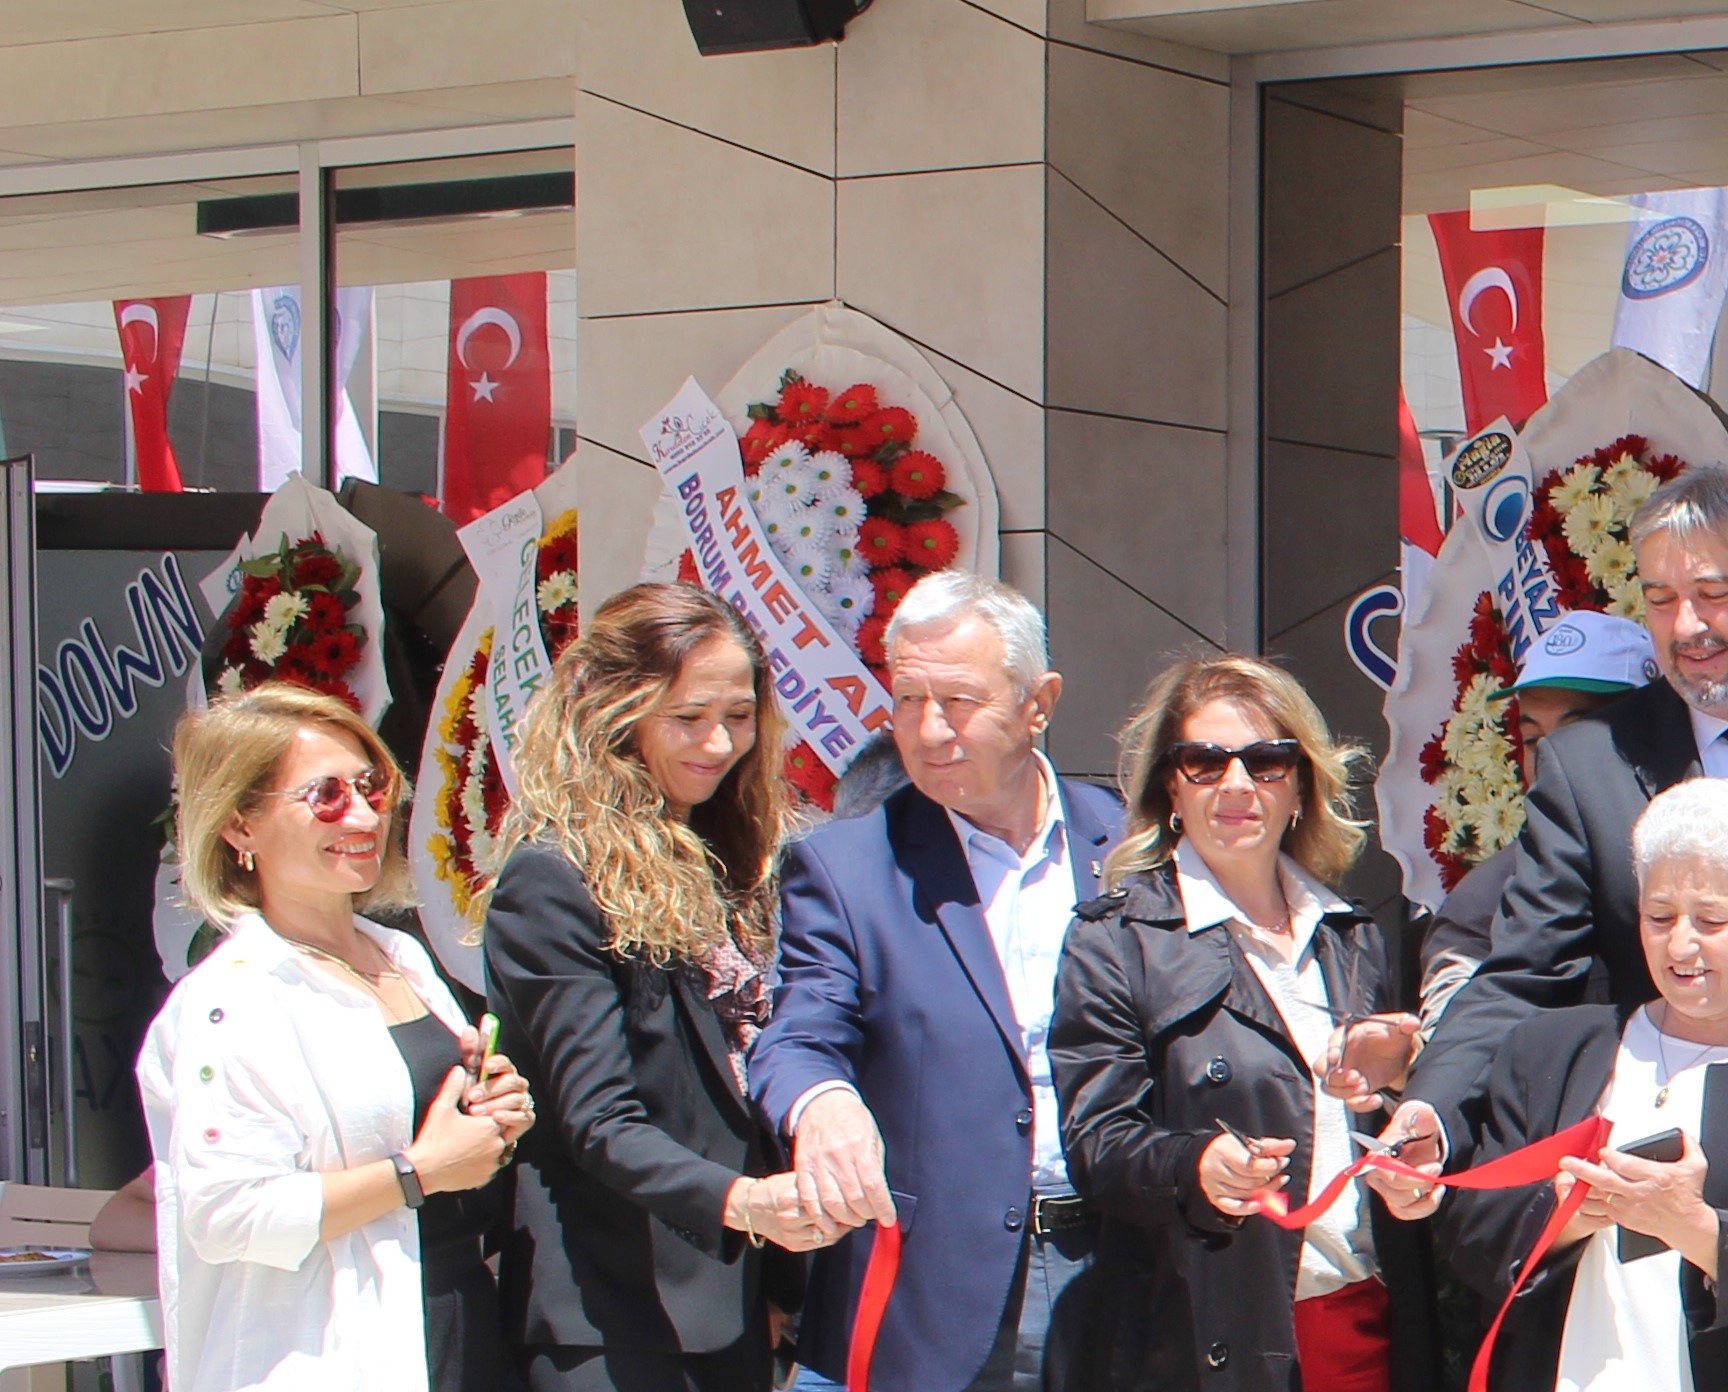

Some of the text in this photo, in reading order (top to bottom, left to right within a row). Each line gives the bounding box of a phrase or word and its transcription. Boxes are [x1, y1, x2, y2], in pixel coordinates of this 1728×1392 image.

[38, 552, 205, 779] DOWN
[677, 472, 733, 592] BODRUM
[730, 590, 857, 759] BEDİYE
[715, 486, 831, 650] AHMET
